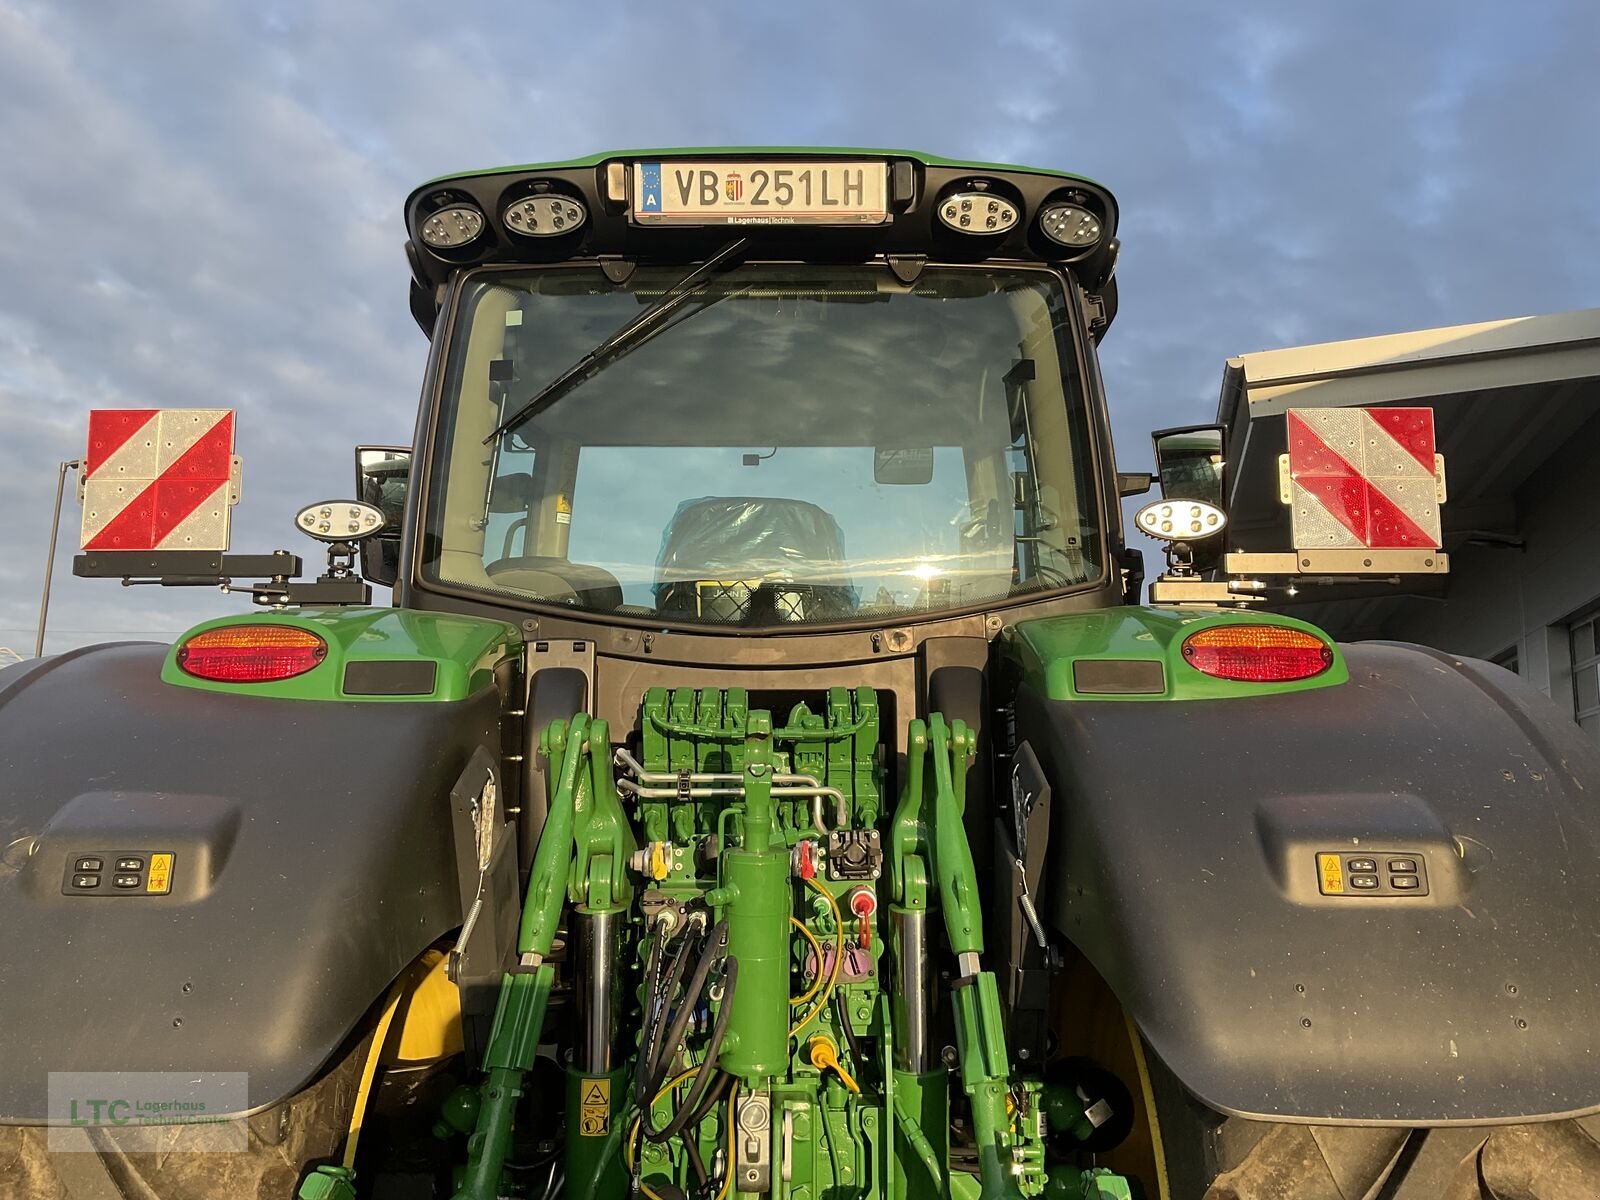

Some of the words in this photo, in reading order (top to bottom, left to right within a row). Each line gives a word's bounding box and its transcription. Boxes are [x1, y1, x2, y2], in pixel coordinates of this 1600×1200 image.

[675, 169, 719, 206] VB
[750, 169, 864, 206] 251LH
[646, 194, 657, 206] A
